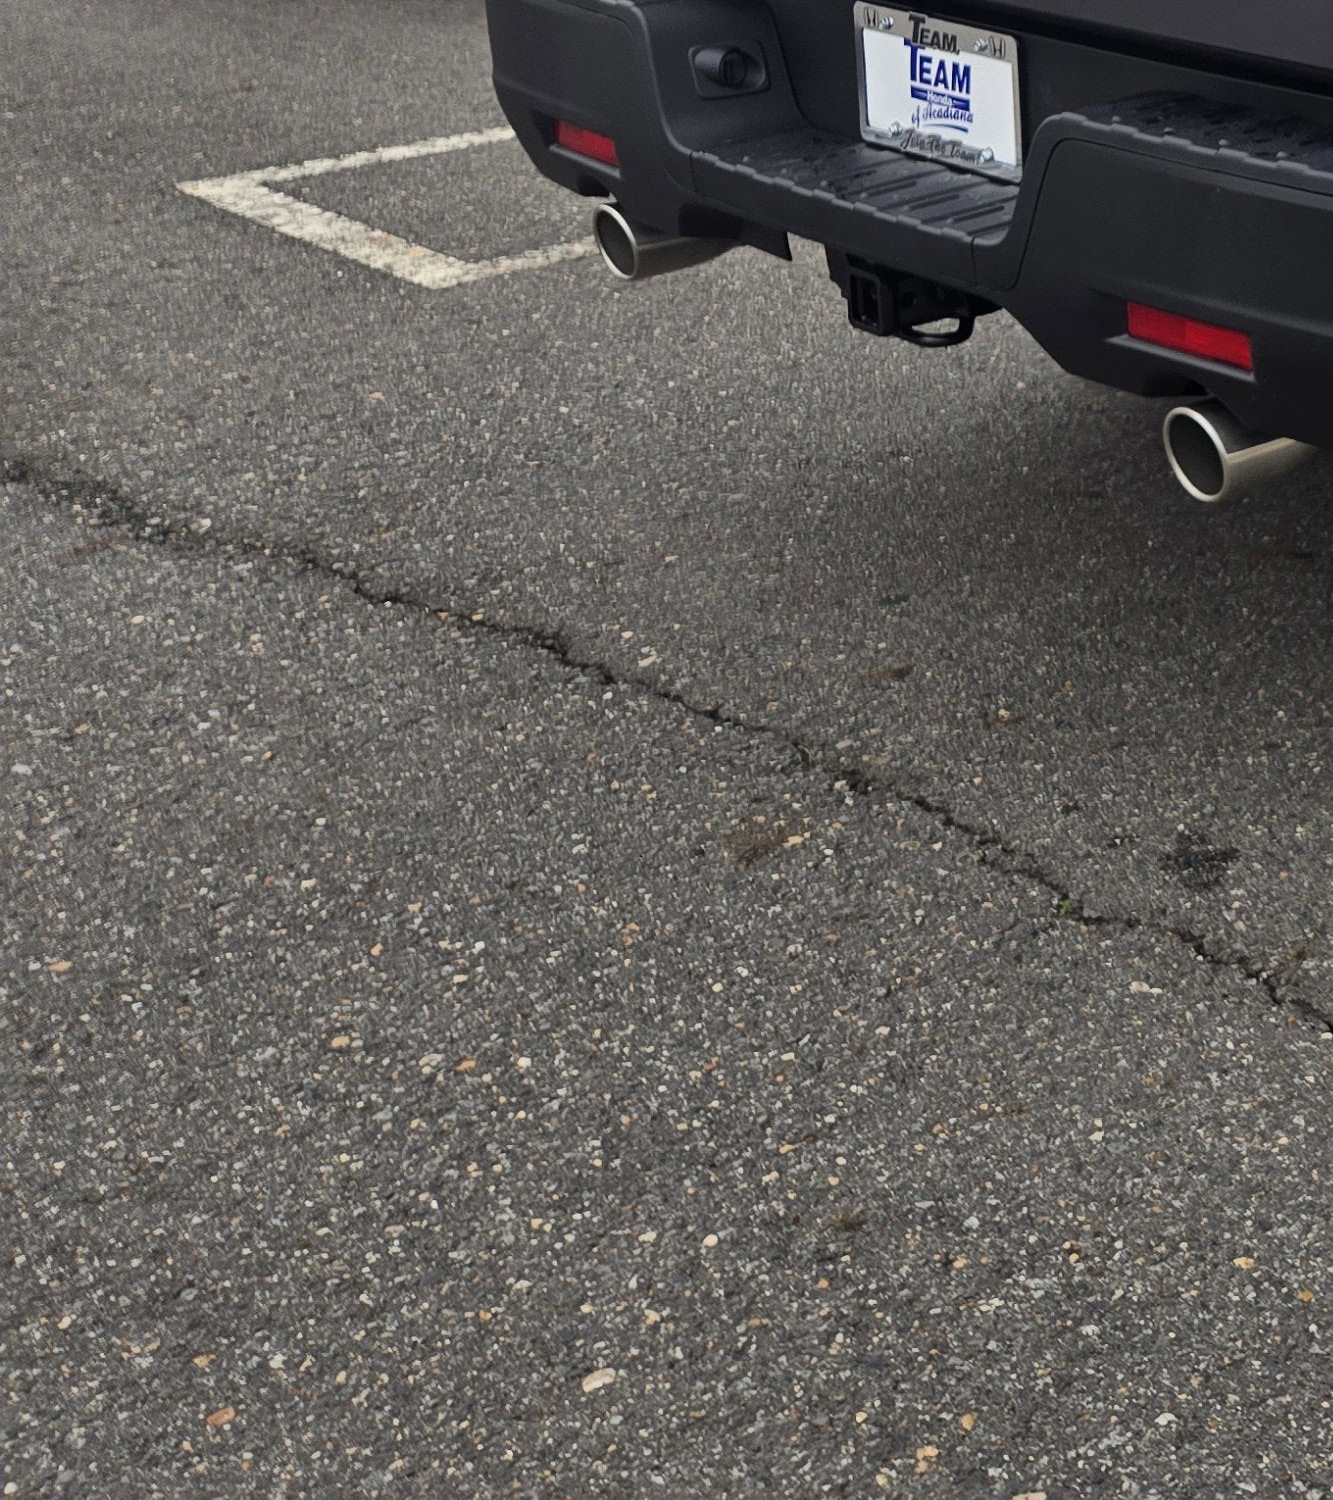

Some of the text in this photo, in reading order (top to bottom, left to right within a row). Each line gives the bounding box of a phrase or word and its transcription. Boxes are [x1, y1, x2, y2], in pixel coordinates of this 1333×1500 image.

[903, 37, 971, 94] TEAM
[911, 99, 974, 128] of Acadiana
